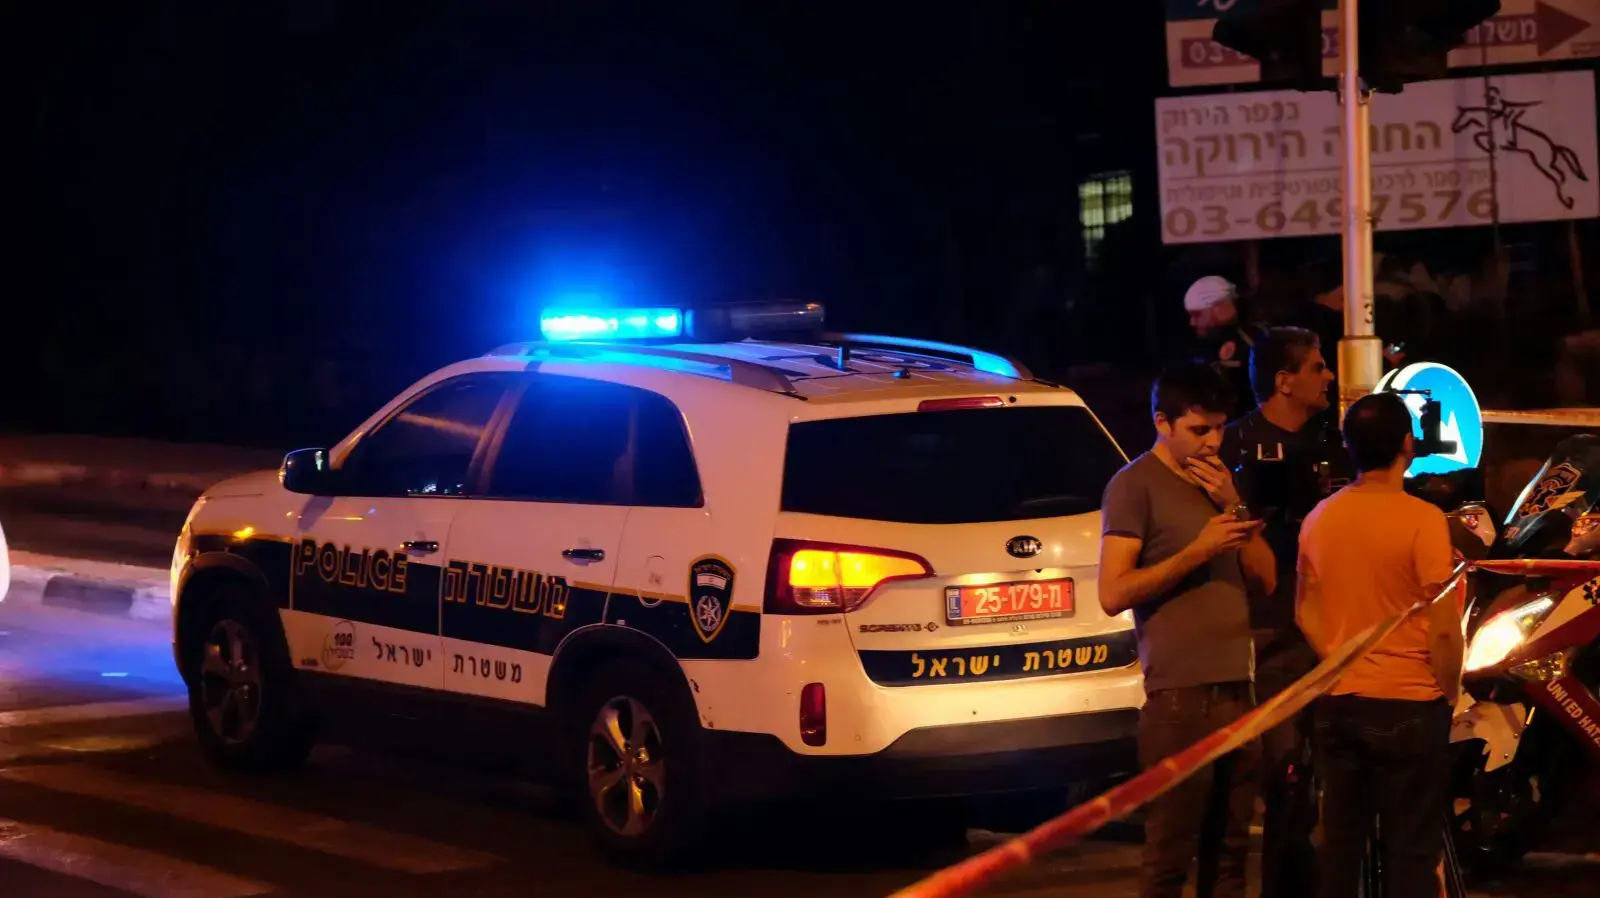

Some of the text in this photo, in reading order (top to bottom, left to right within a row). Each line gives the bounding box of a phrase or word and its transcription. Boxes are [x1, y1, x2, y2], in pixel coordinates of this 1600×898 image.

[1161, 106, 1229, 135] הירוק
[1164, 129, 1306, 177] הירוקה
[296, 537, 408, 593] POLICE
[1012, 539, 1042, 554] KIA
[445, 560, 570, 619] משטרה
[371, 636, 523, 684] משטרת ישראל
[911, 644, 1108, 679] משטרת ישראל
[1546, 677, 1584, 719] UNITED
